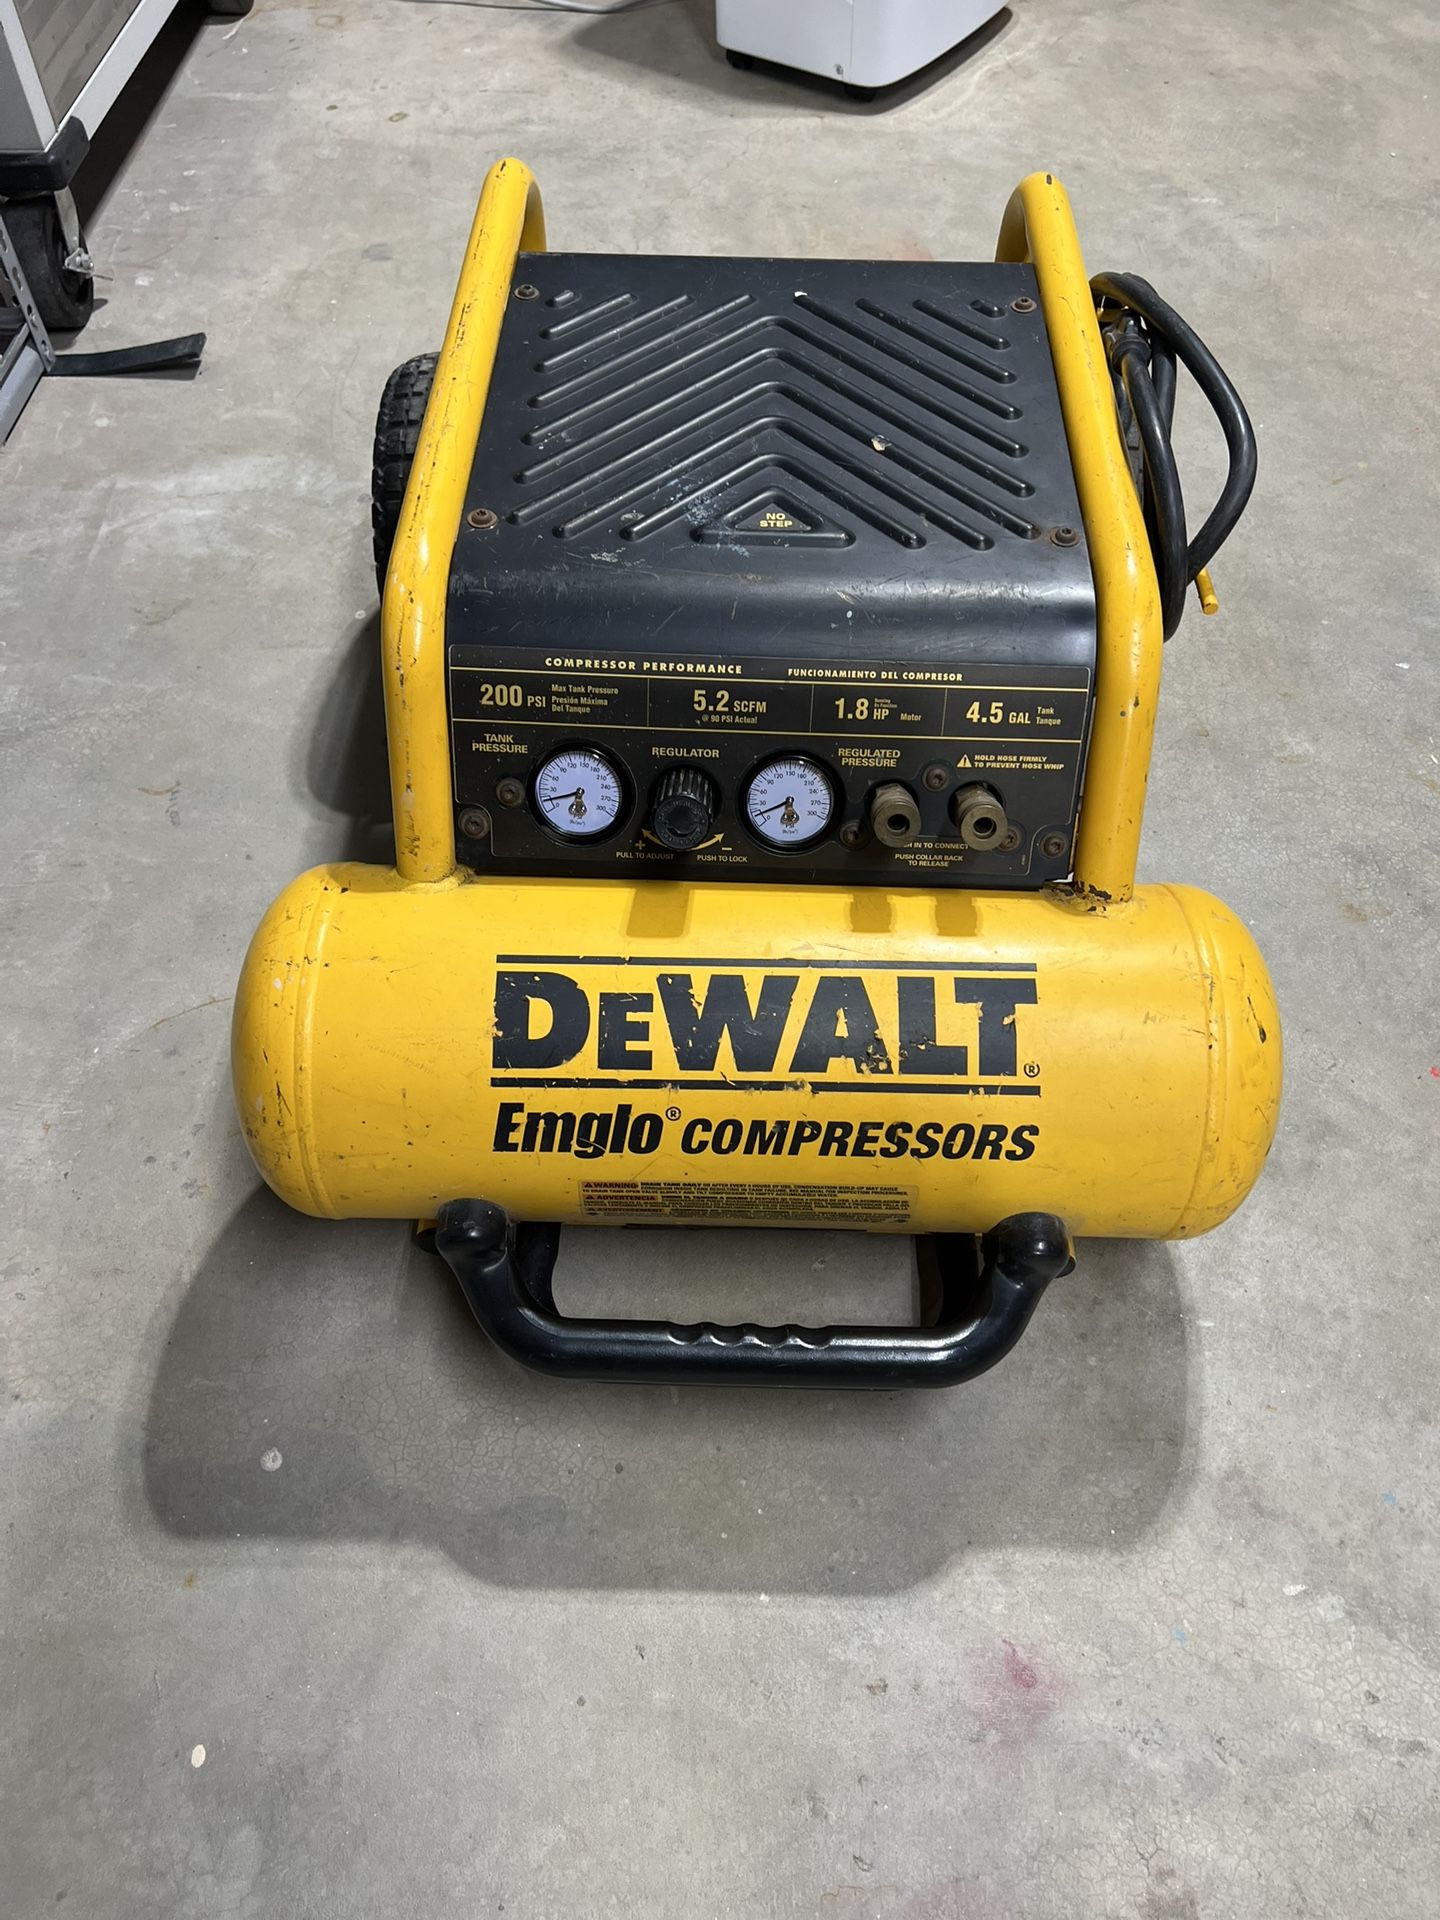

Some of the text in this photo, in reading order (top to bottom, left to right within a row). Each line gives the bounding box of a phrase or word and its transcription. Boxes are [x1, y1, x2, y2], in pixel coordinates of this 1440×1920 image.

[766, 512, 786, 520] NO
[759, 520, 793, 528] STEP
[545, 658, 742, 675] COMPRESSOR PERFORMANCE
[788, 668, 963, 682] FUNCIONAMIENTO DEL COMPRESOR
[551, 683, 619, 695] Max Tank Pressure
[480, 683, 546, 708] 200 PSI
[551, 695, 608, 706] Presión Máxima
[693, 689, 767, 713] 5.2 SCFM
[551, 704, 591, 714] Del Tanque
[835, 697, 869, 721] 1.8
[873, 708, 890, 720] HP
[900, 713, 922, 721] Motor
[966, 701, 1031, 724] 4.5 GAL
[1037, 706, 1055, 715] Tank
[710, 714, 720, 723] 90
[720, 715, 733, 723] PSI
[734, 715, 758, 724] Actual
[1036, 716, 1062, 726] Tanque
[484, 733, 514, 744] TANK
[472, 742, 528, 754] PRESSURE
[651, 746, 720, 758] REGULATOR
[838, 747, 901, 758] REGULATED
[841, 757, 897, 767] PRESSURE
[1019, 755, 1047, 763] FIRMLY
[986, 761, 1020, 769] PREVENT
[1021, 762, 1043, 770] HOSE
[646, 852, 674, 860] ADJUST
[697, 854, 717, 862] PUSH
[681, 1116, 1040, 1161] COMPRESSORS
